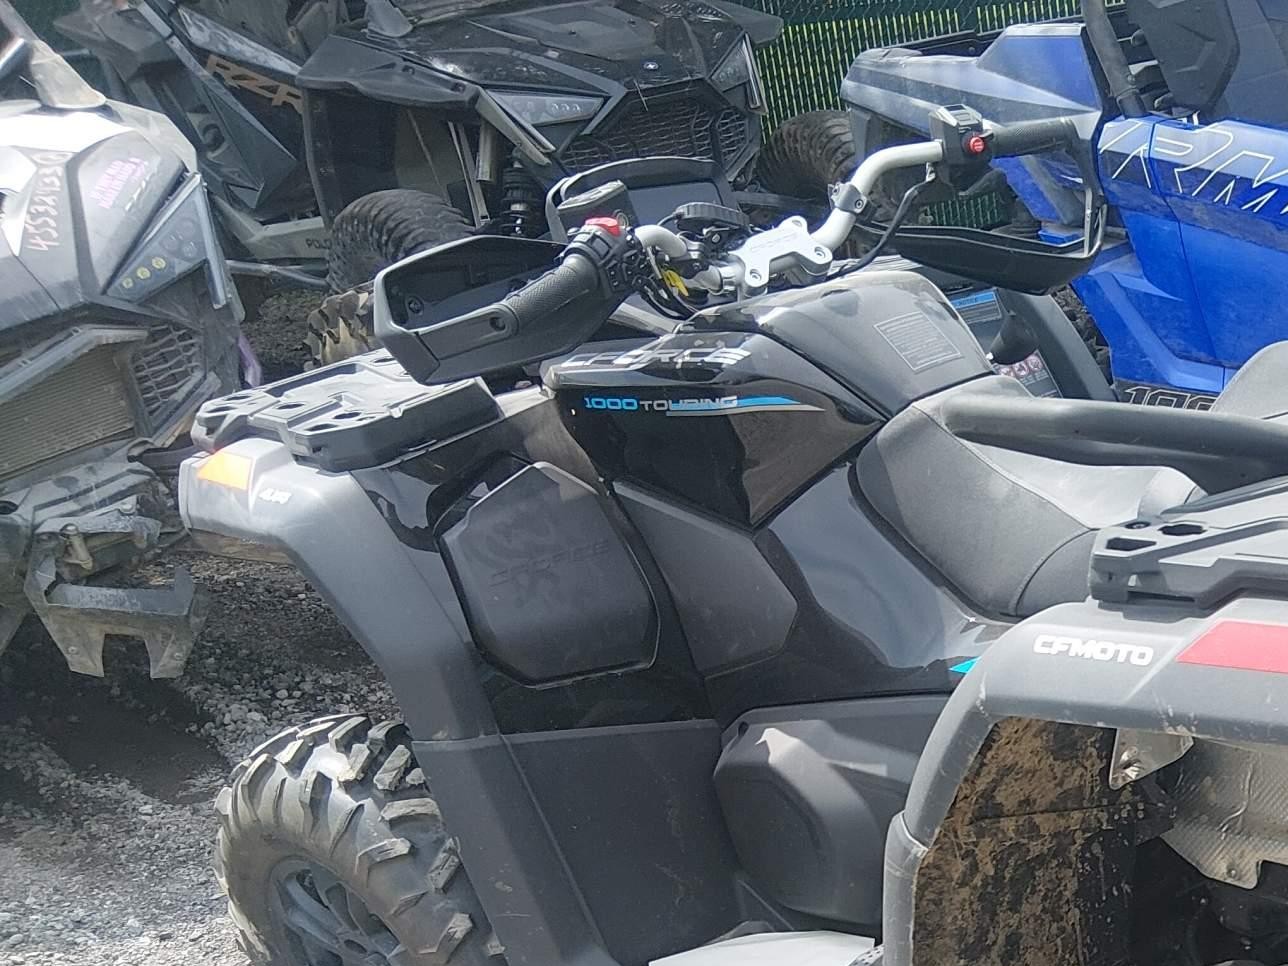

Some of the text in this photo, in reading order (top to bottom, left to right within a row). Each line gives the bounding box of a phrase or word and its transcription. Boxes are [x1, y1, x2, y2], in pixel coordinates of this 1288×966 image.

[206, 54, 304, 114] RZR
[584, 395, 738, 411] 1000 TOURING
[1033, 634, 1154, 666] CFMOTO
